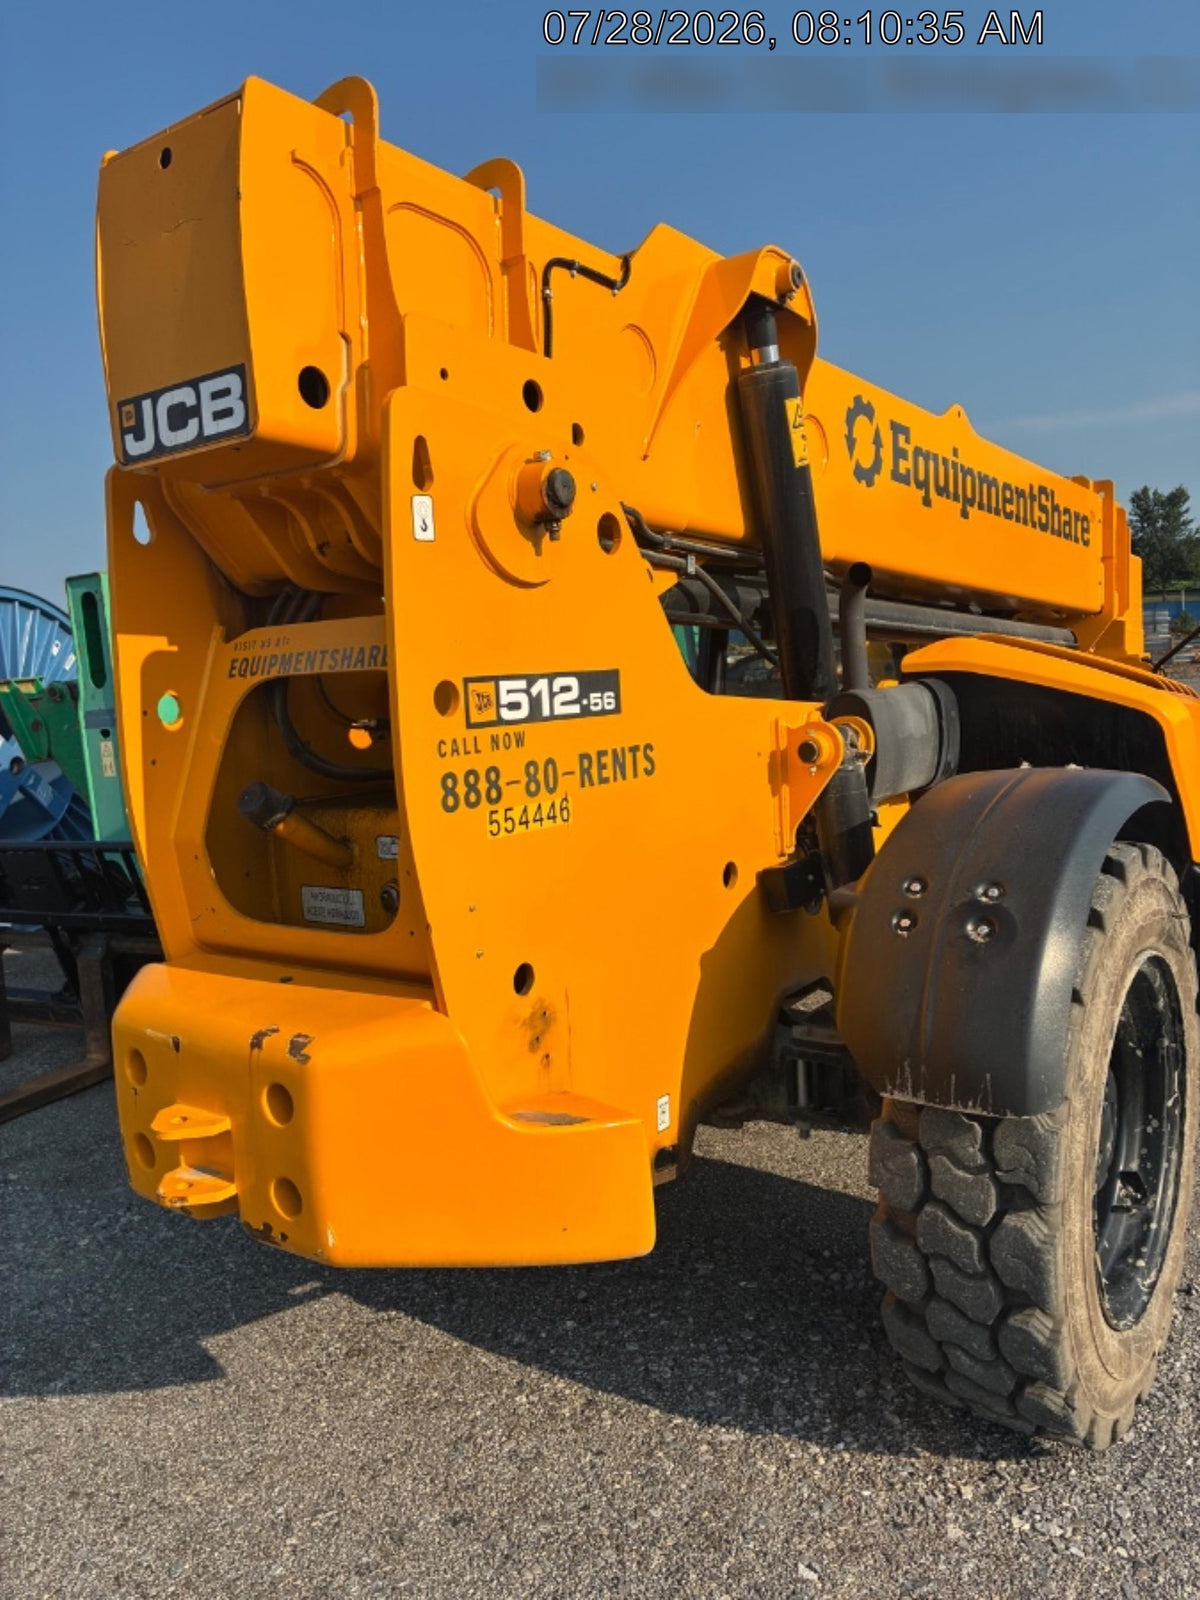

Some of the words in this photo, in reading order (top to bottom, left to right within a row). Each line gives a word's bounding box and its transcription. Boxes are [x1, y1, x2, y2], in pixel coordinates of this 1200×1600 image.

[123, 372, 246, 456] JCB
[889, 419, 1091, 548] EquipmentShare
[437, 735, 482, 759] CALL
[490, 730, 526, 752] NOW
[440, 742, 656, 814] 888-80-RENTS
[488, 793, 571, 837] 554446
